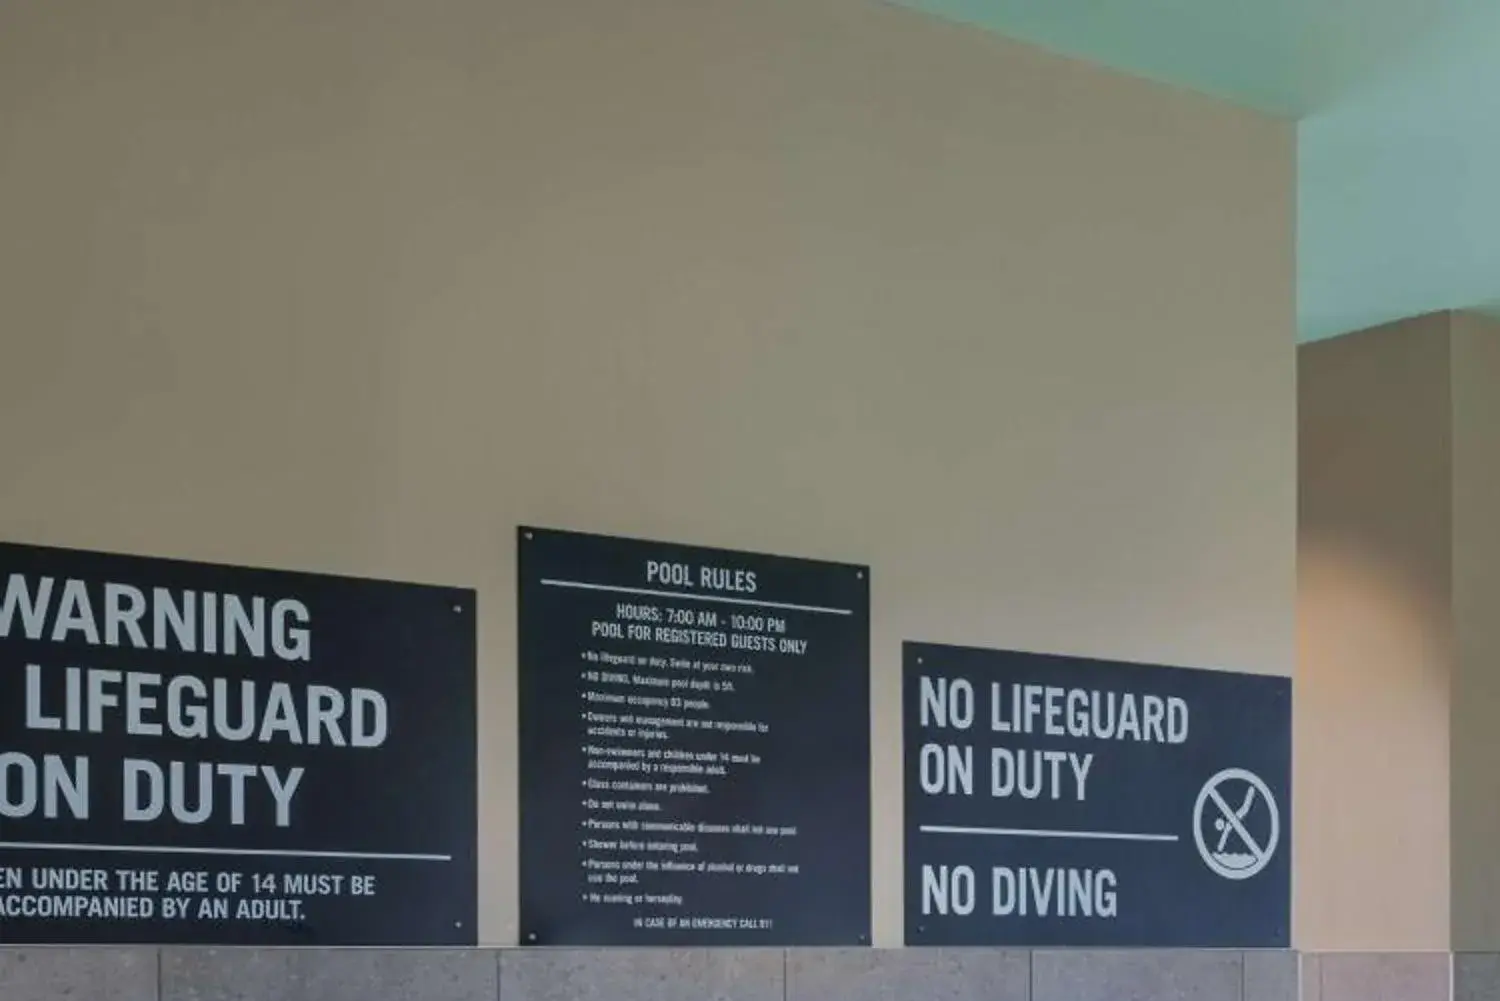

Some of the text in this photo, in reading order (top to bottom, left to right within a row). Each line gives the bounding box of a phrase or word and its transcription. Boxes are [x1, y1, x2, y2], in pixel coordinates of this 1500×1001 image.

[647, 560, 757, 593] POOL RULES
[0, 573, 312, 661] WARNING
[591, 621, 808, 655] POOL FOR REGISTERED GUESTS ONLY
[616, 602, 662, 622] HOURS:
[666, 607, 694, 625] 7:00
[697, 611, 717, 628] AM
[731, 614, 764, 632] 10:00
[767, 618, 786, 634] PM
[26, 664, 388, 748] LIFEGUARD
[920, 676, 1189, 743] NO LIFEGUARD
[0, 752, 304, 826] ON DUTY
[920, 743, 1094, 800] ON DUTY
[32, 867, 108, 890] UNDER
[116, 869, 159, 892] THE
[166, 871, 209, 893] AGE
[216, 872, 243, 893] OF
[252, 873, 276, 893] 14
[284, 874, 345, 894] MUST
[351, 875, 375, 895] BE
[922, 864, 1117, 917] NO DIVING
[161, 897, 191, 919] BY
[198, 897, 229, 919] AN
[236, 898, 305, 921] ADULT.
